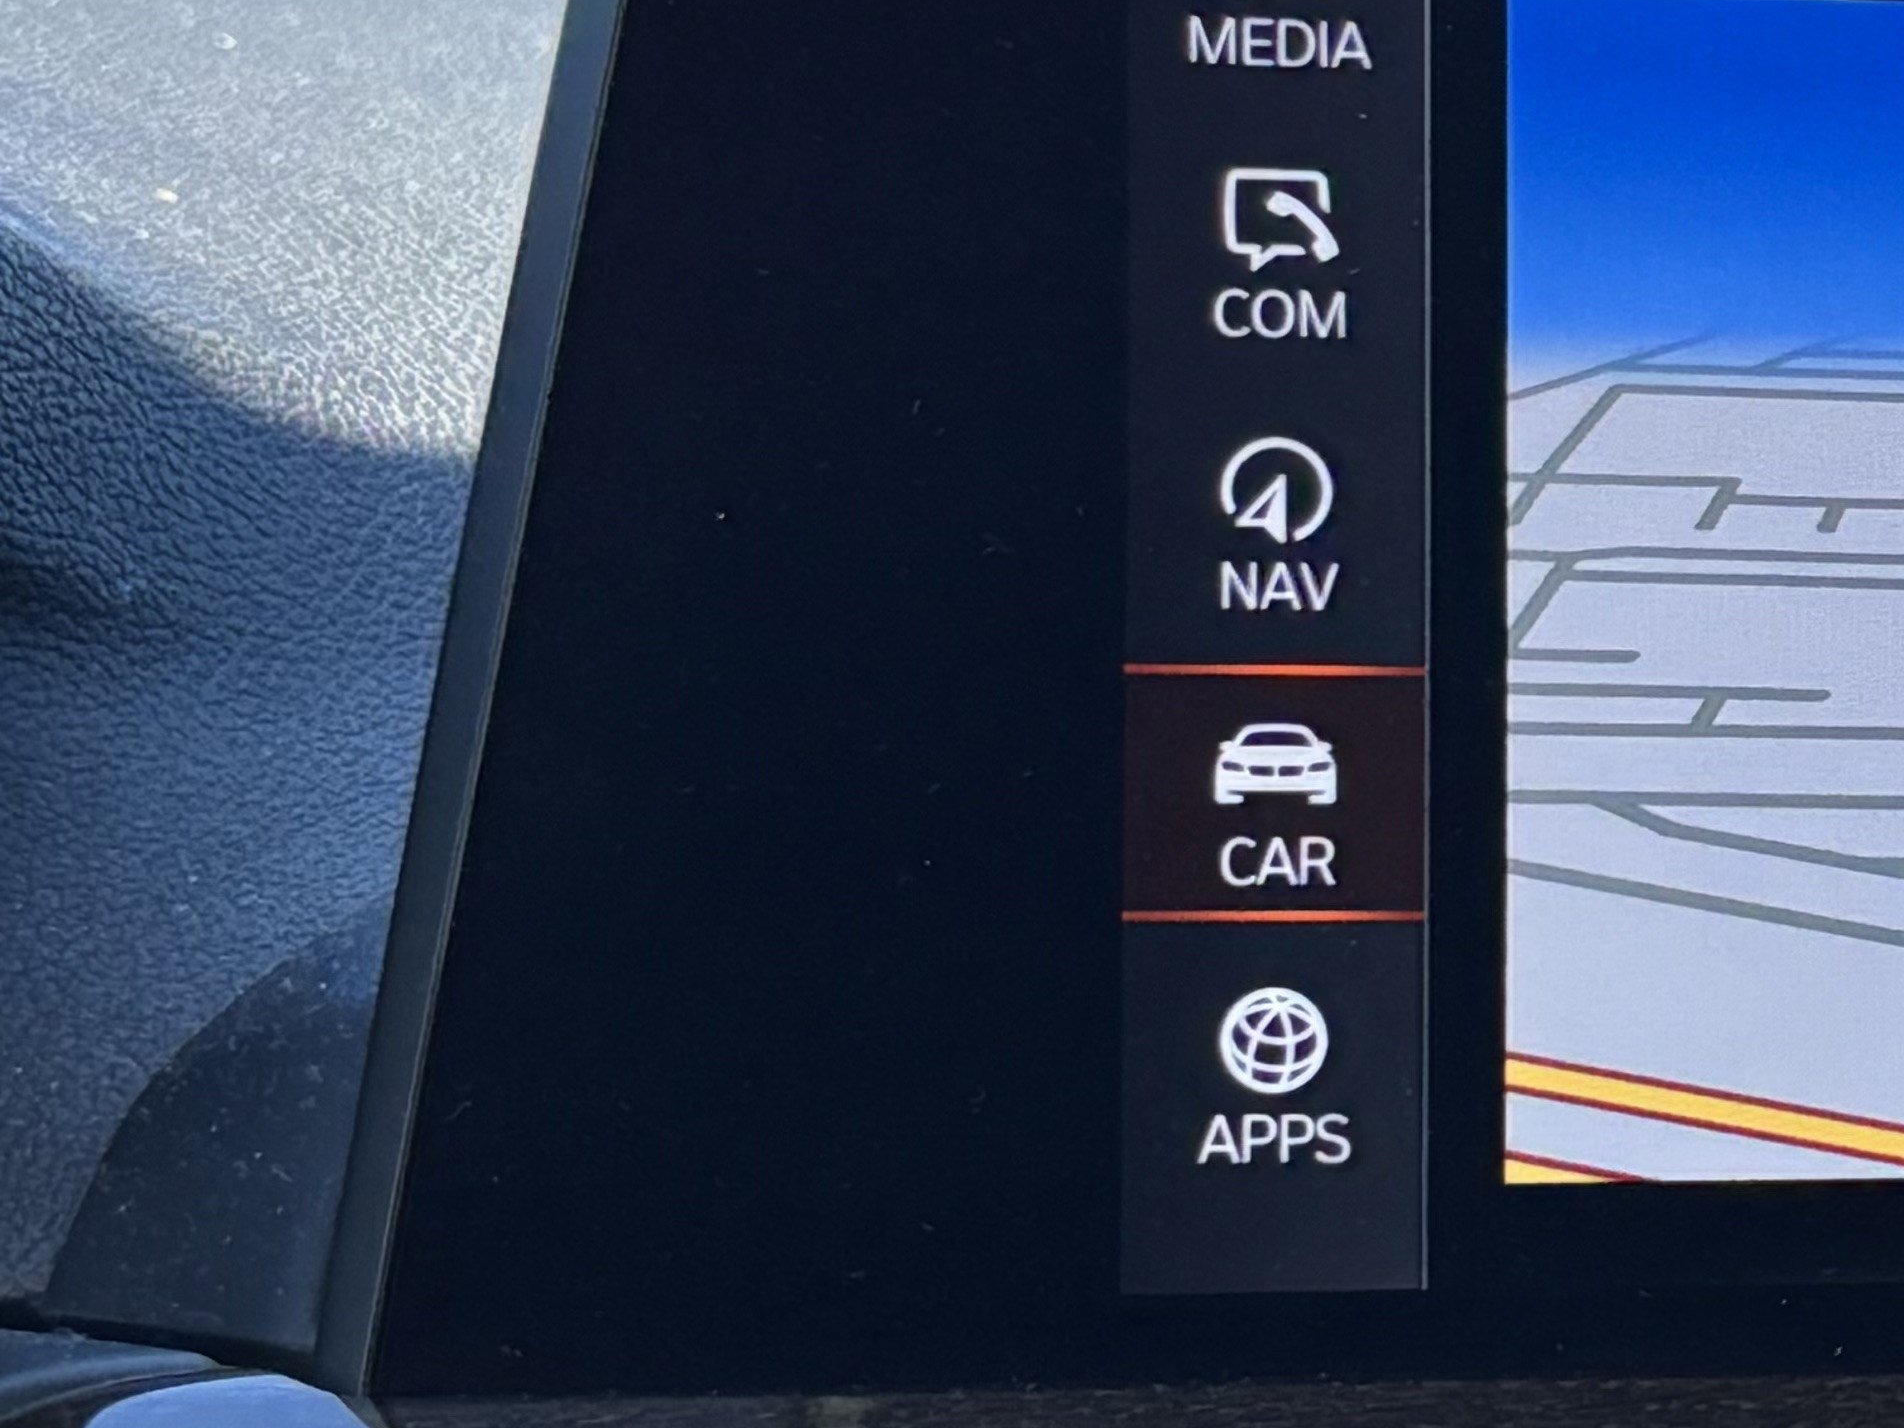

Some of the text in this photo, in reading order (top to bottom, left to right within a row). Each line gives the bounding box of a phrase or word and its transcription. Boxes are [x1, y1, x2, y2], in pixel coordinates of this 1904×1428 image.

[1188, 15, 1372, 70] MEDIA
[1213, 287, 1346, 339] COM
[1220, 560, 1339, 611] NAV
[1220, 836, 1336, 887] CAR
[1197, 1113, 1351, 1164] APPS
